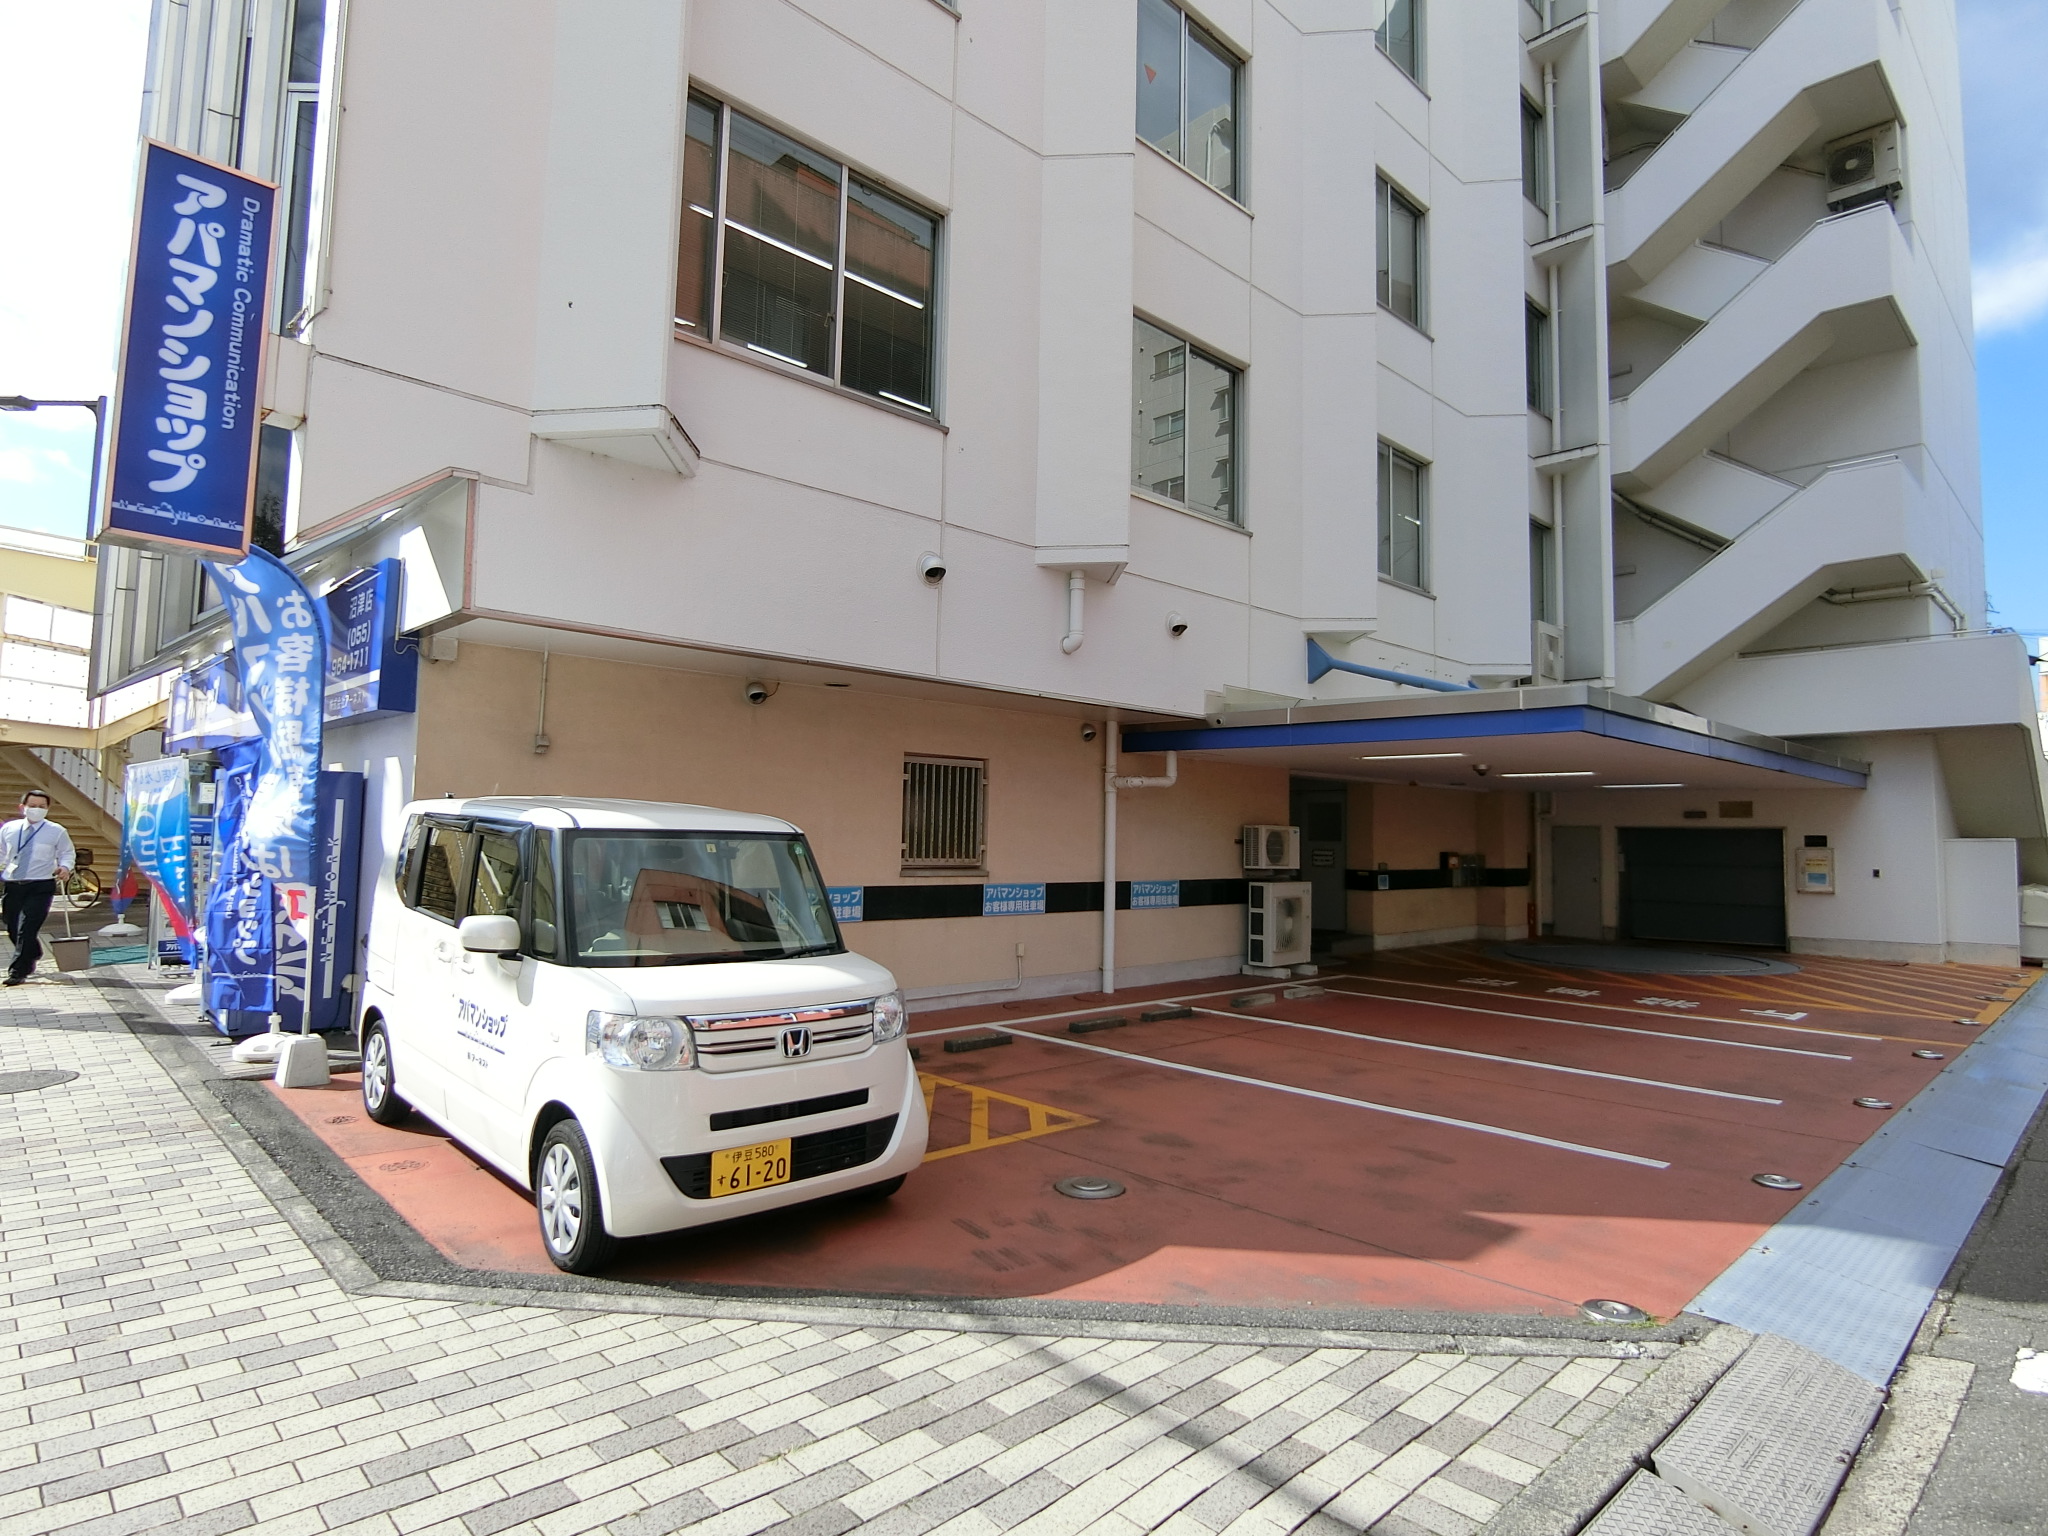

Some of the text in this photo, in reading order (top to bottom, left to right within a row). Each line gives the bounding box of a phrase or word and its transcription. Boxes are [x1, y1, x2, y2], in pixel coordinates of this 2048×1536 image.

[221, 196, 260, 430] Dramatic Communication
[148, 173, 227, 493] アパマンショップ
[347, 620, 371, 650] (055)
[985, 886, 1044, 899] アパマンショップ
[1132, 884, 1178, 895] アパマンショップ
[1132, 895, 1178, 907] お客様専用駐車場
[984, 899, 1045, 913] お客様専用駐車場
[458, 998, 508, 1038] アパマンショップ
[732, 1144, 775, 1165] 伊豆 580
[716, 1157, 786, 1190] す 61-20
